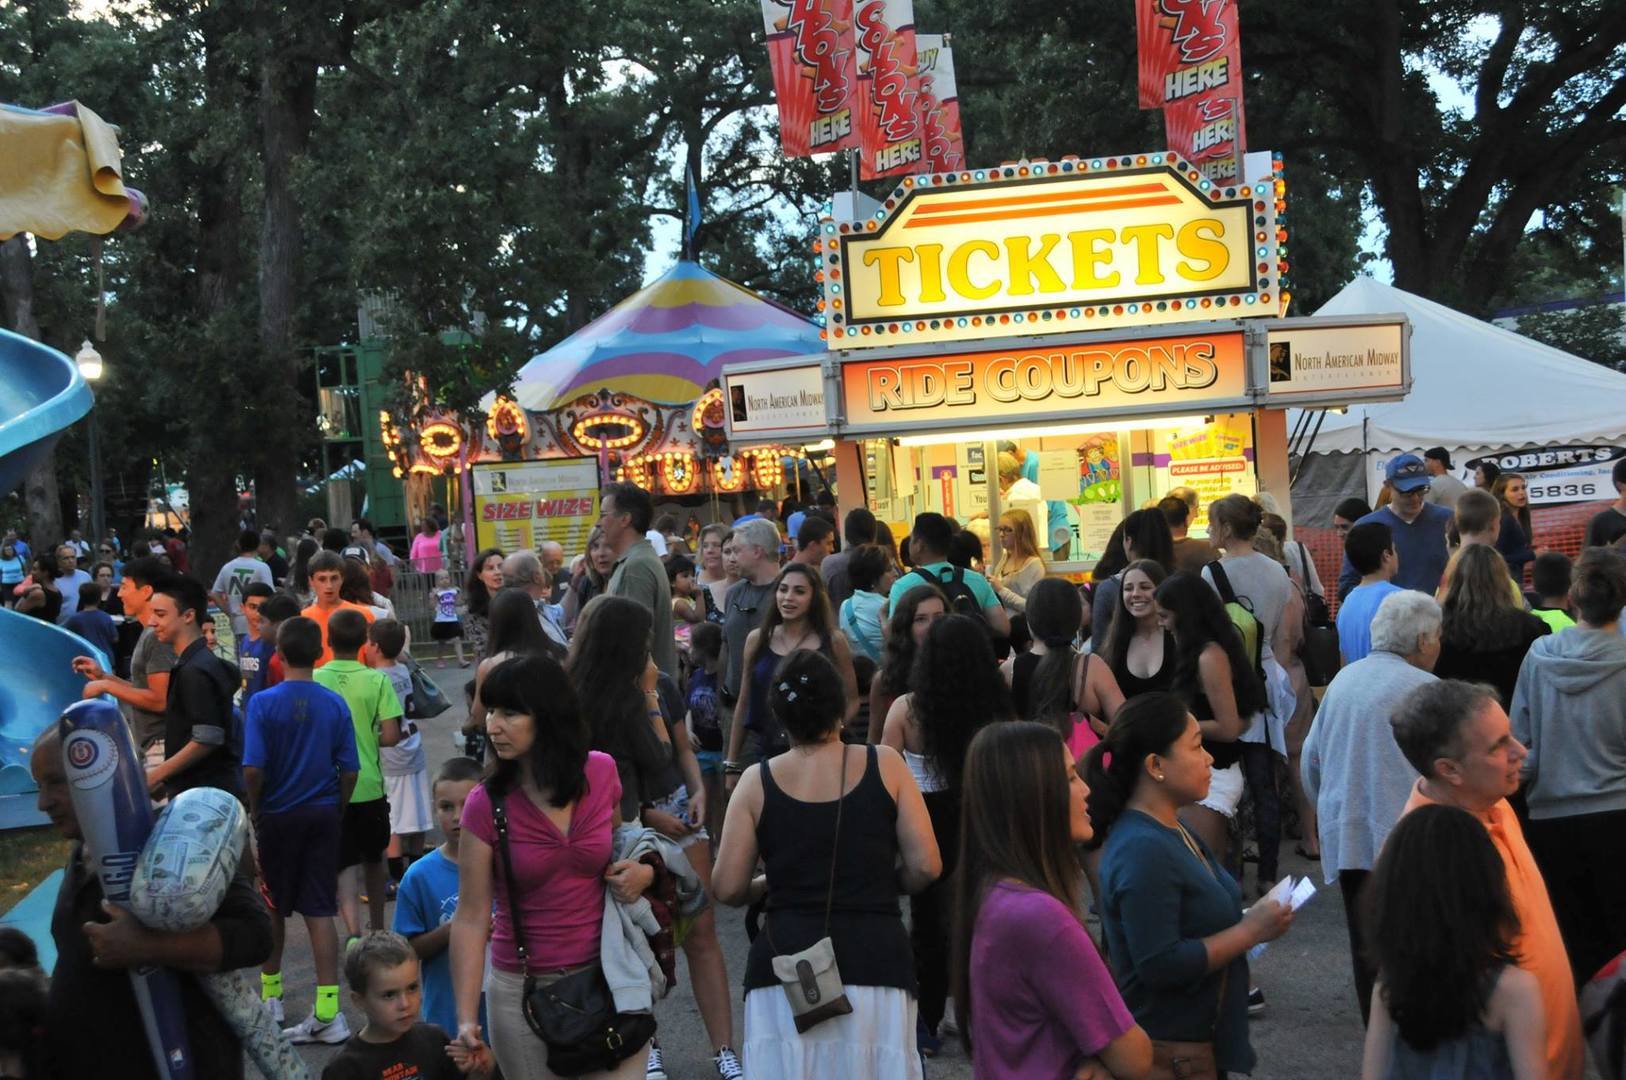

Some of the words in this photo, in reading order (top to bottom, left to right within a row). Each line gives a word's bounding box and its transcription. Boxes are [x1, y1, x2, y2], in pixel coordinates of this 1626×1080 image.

[856, 1, 918, 141] COUPONS
[1165, 57, 1229, 102] HERE
[810, 108, 850, 147] HERE
[875, 138, 921, 172] HERE
[863, 219, 1230, 307] TICKETS
[1294, 352, 1321, 371] NORTH
[1325, 351, 1364, 368] AMERICAN
[1367, 347, 1399, 366] MIDWAY
[867, 361, 977, 411] RIDE
[984, 342, 1217, 402] COUPONS
[748, 394, 768, 411] NORTH
[769, 392, 798, 409] AMERICAN
[1171, 465, 1198, 474] PLEASE
[1199, 464, 1209, 472] BE
[1529, 483, 1597, 499] 5836
[483, 501, 532, 522] SIZE
[535, 497, 593, 518] WIZE
